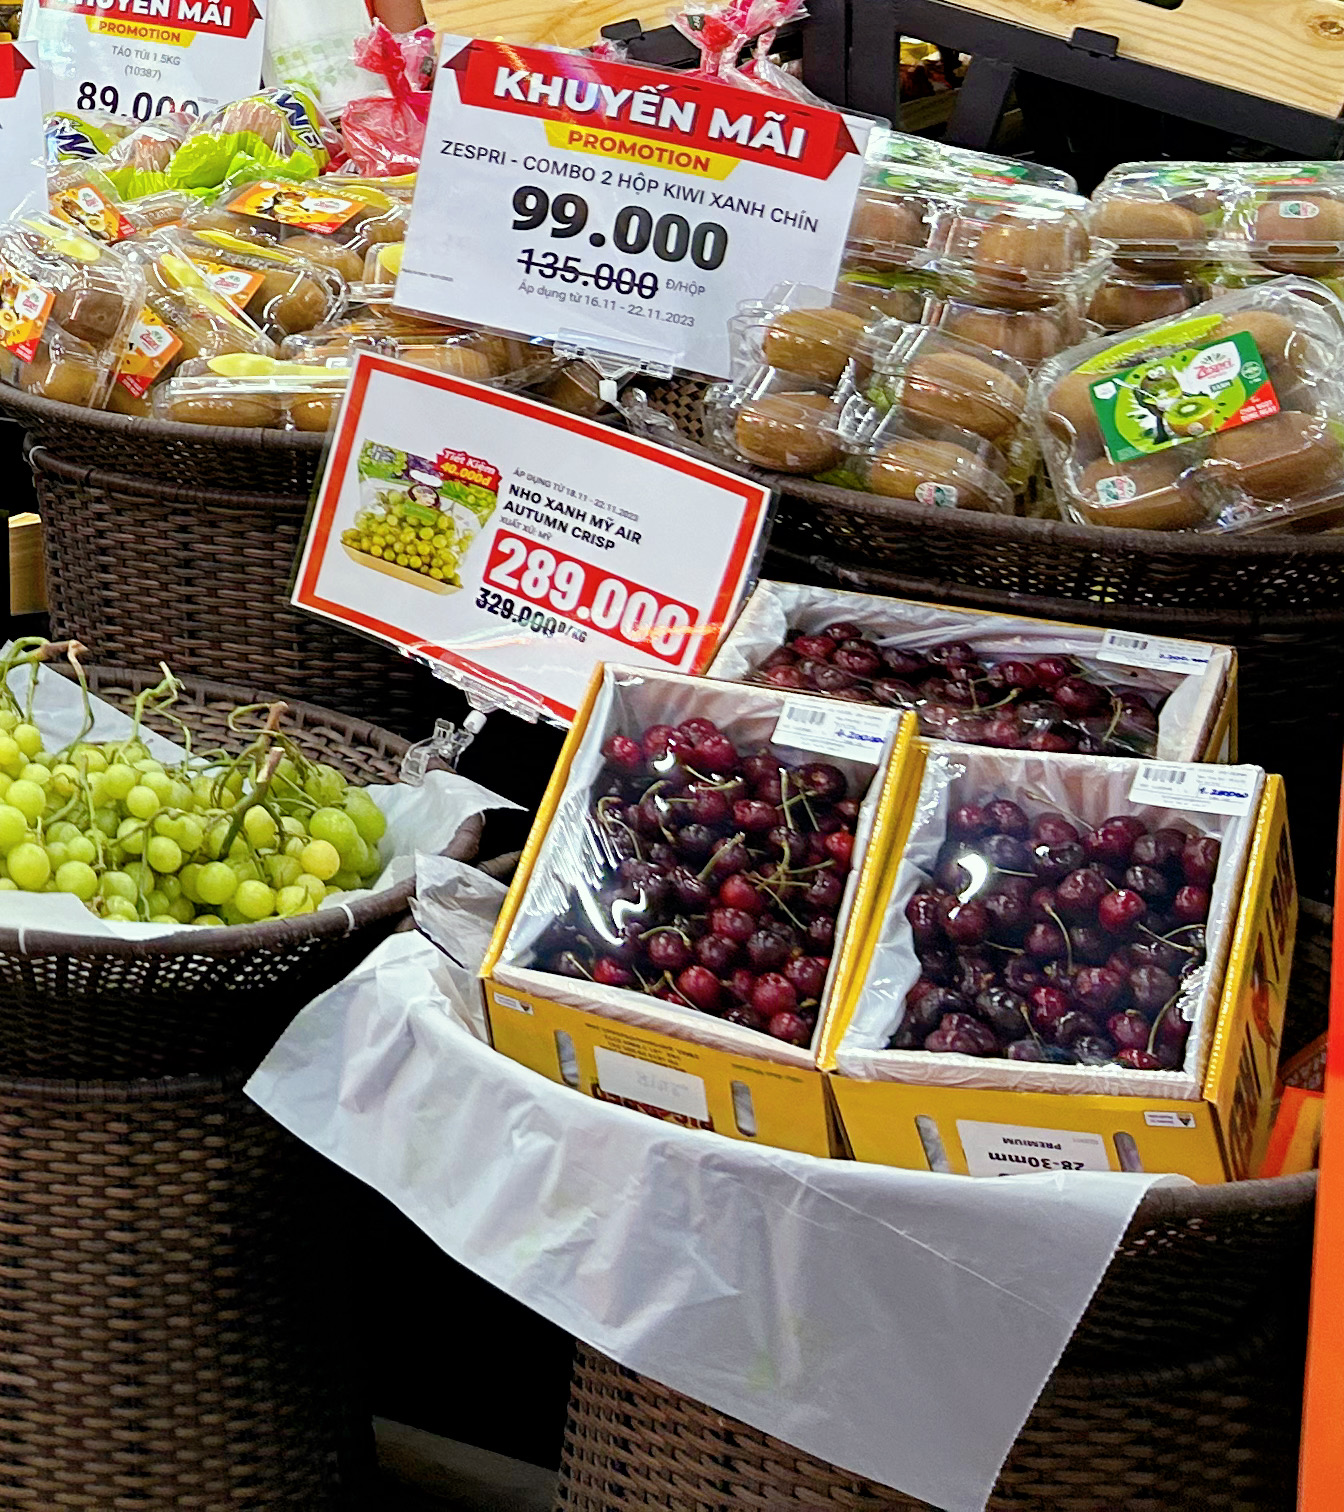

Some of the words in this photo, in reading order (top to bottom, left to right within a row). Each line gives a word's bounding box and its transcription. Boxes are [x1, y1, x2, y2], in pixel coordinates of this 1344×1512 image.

[98, 19, 181, 43] PROMOTION
[111, 44, 133, 60] TÁO
[134, 47, 152, 62] TÚI
[123, 65, 163, 81] (10387)
[493, 66, 698, 135] KHUYẾN
[708, 107, 807, 159] MÃI
[567, 129, 711, 172] PROMOTION
[440, 139, 506, 166] ZESPRI
[523, 155, 596, 183] COMBO
[600, 170, 613, 186] 2
[617, 171, 660, 195] HỘP
[663, 178, 705, 205] KIWI
[710, 191, 766, 218] XANH
[770, 205, 819, 233] CHÍN
[512, 184, 729, 271] 99.000
[518, 247, 660, 300] 135.000
[665, 277, 706, 297] Đ/HỘP
[518, 279, 535, 299] Áp
[536, 285, 567, 306] dụng
[569, 290, 582, 304] từ
[584, 293, 617, 311] 16.11
[627, 301, 695, 328] 22.11.2023
[503, 501, 568, 534] AUTUMN
[571, 527, 616, 553] CRISP
[508, 484, 542, 504] NHO
[544, 496, 586, 522] XANH
[589, 513, 615, 534] MỸ
[615, 525, 642, 544] AIR
[474, 587, 557, 640] 329.000
[488, 537, 692, 658] 289.000
[989, 1151, 1085, 1171] 28-30mm
[1002, 1137, 1062, 1150] PREMIUM
